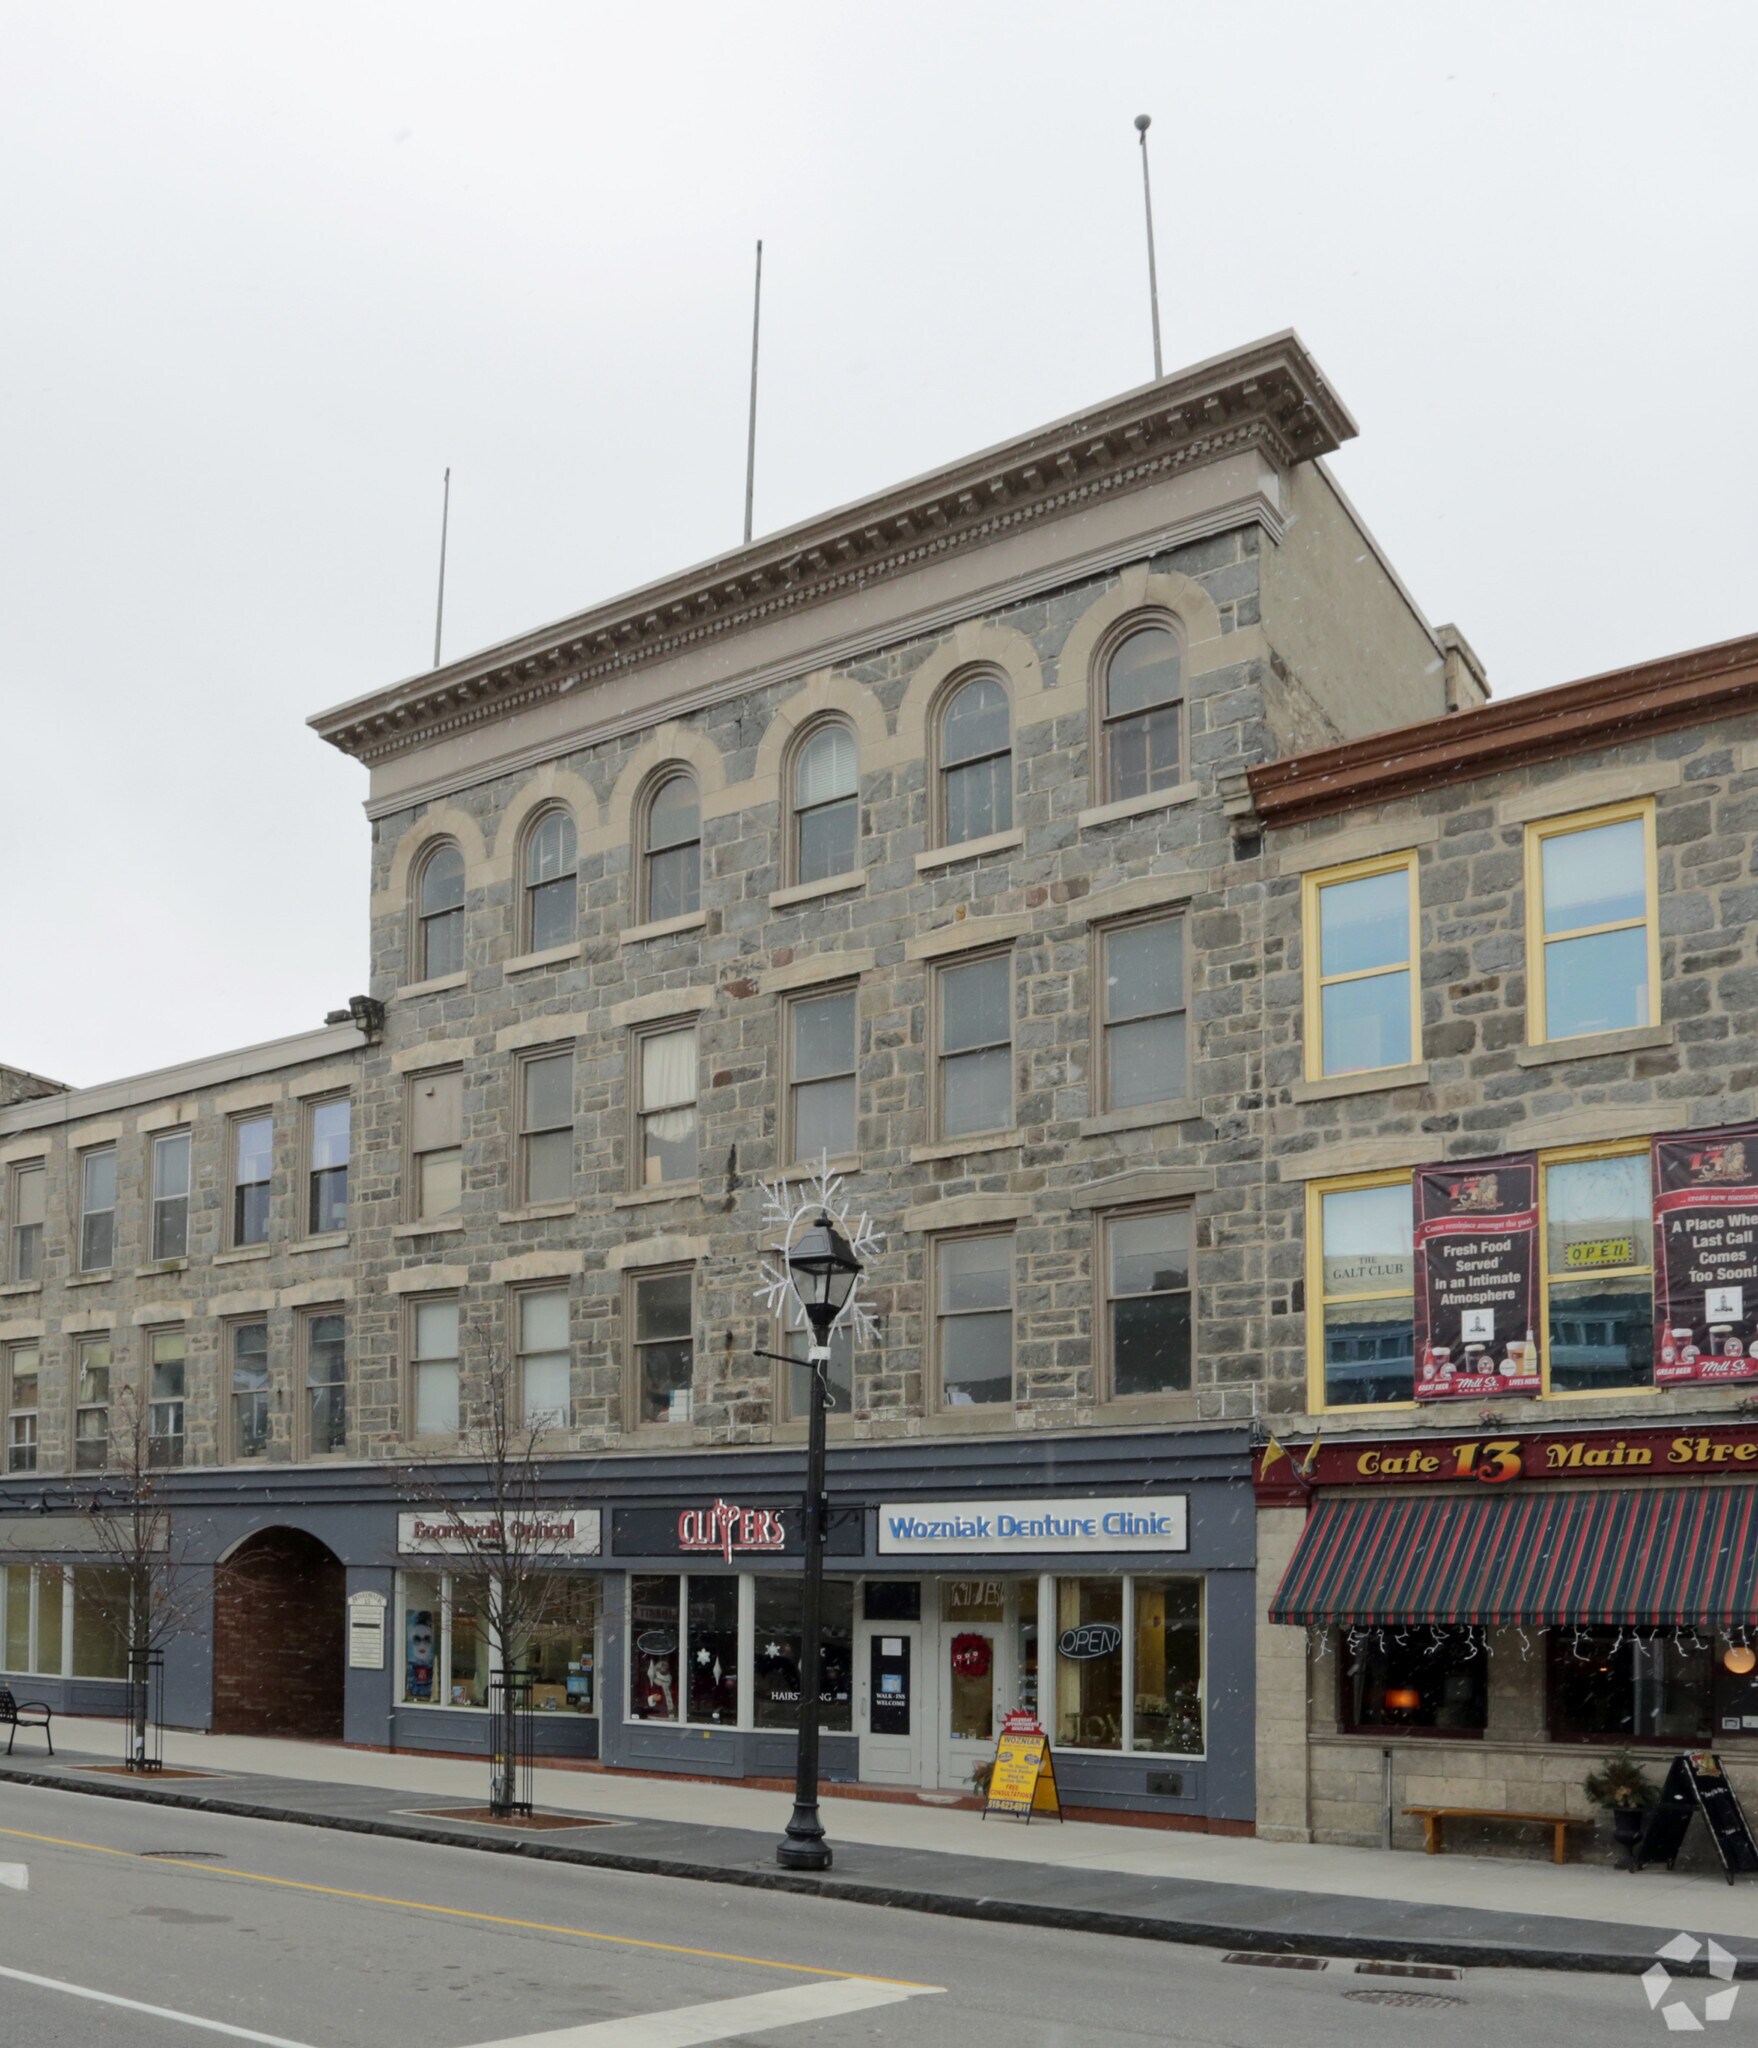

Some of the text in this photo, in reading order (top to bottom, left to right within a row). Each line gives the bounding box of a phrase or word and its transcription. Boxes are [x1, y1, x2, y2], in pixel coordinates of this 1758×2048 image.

[1505, 1219, 1517, 1227] the
[1672, 1220, 1683, 1233] A
[1685, 1218, 1725, 1232] Place
[1692, 1230, 1753, 1248] Last Call
[1443, 1239, 1511, 1257] Fresh Food
[1359, 1255, 1377, 1264] THE
[1455, 1257, 1499, 1272] Served
[1699, 1250, 1747, 1265] Comes
[1333, 1263, 1403, 1279] GALT CLUB
[1688, 1264, 1758, 1283] Too Soon!
[1435, 1271, 1521, 1290] in an Intimate
[1440, 1289, 1516, 1305] Atmosphere
[1699, 1359, 1749, 1373] Mill St.
[1456, 1376, 1499, 1389] Mill St.
[1356, 1437, 1758, 1483] Cafe 13 Main Stre
[888, 1511, 1172, 1539] Wozniak Denture Clinic
[1060, 1630, 1117, 1653] OPEN
[876, 1699, 906, 1707] WELCOME
[1004, 1736, 1041, 1745] WOZNIAK
